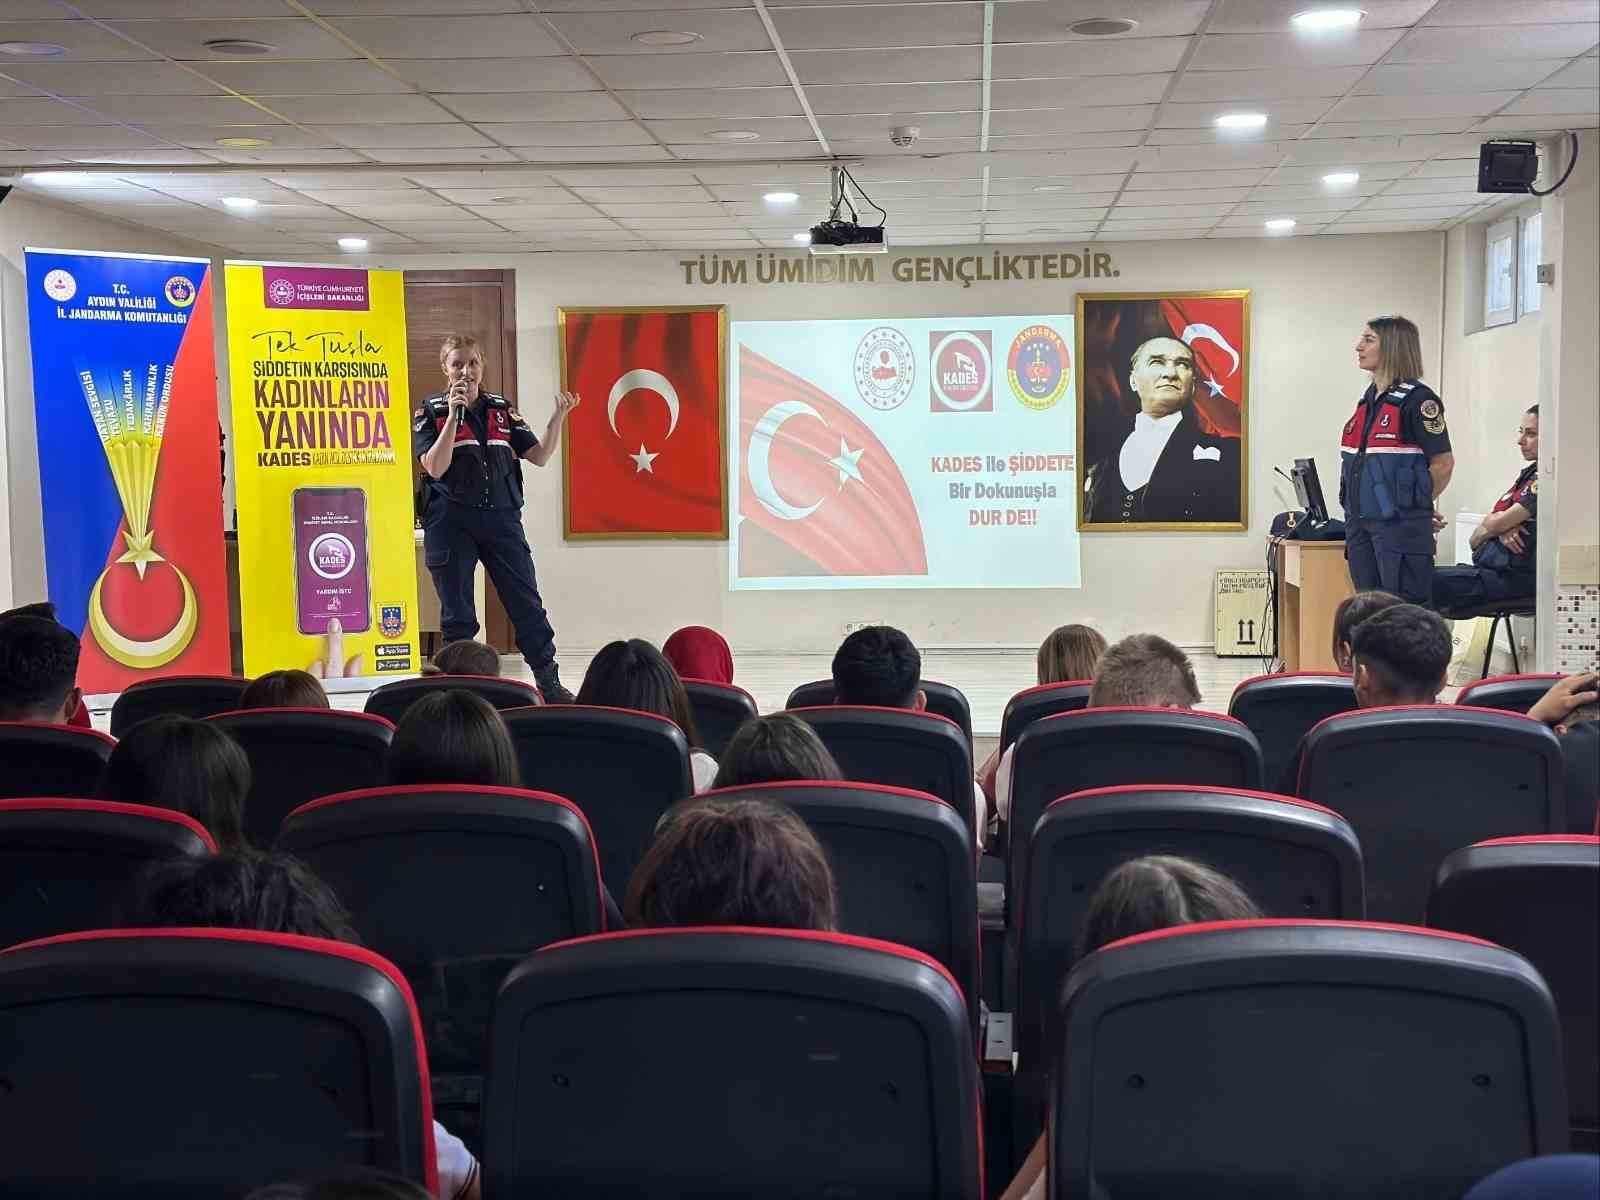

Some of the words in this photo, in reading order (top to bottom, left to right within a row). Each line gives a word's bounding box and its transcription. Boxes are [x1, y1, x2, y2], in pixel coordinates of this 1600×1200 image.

[680, 254, 748, 285] TÜM
[756, 253, 875, 284] ÜMİDİM
[892, 247, 1121, 289] GENÇLİKTEDİR.
[113, 284, 130, 294] T.C.
[88, 296, 116, 308] AYDIN
[68, 308, 122, 321] JANDARMA
[124, 311, 187, 324] KOMUTANLIĞI
[252, 330, 304, 361] Tek
[943, 372, 979, 385] KADES
[143, 363, 158, 434] KAHRAMANLIK
[255, 379, 390, 409] KADINLARIN
[256, 410, 391, 449] YANINDA
[257, 452, 311, 467] KADES
[931, 456, 983, 472] KADES
[1008, 451, 1075, 476] ŞİDDETE
[949, 482, 972, 499] Bir
[974, 481, 1057, 502] Dokunuşla
[969, 509, 1001, 525] DUR
[1006, 508, 1038, 525] DE!!
[319, 556, 346, 564] KADES
